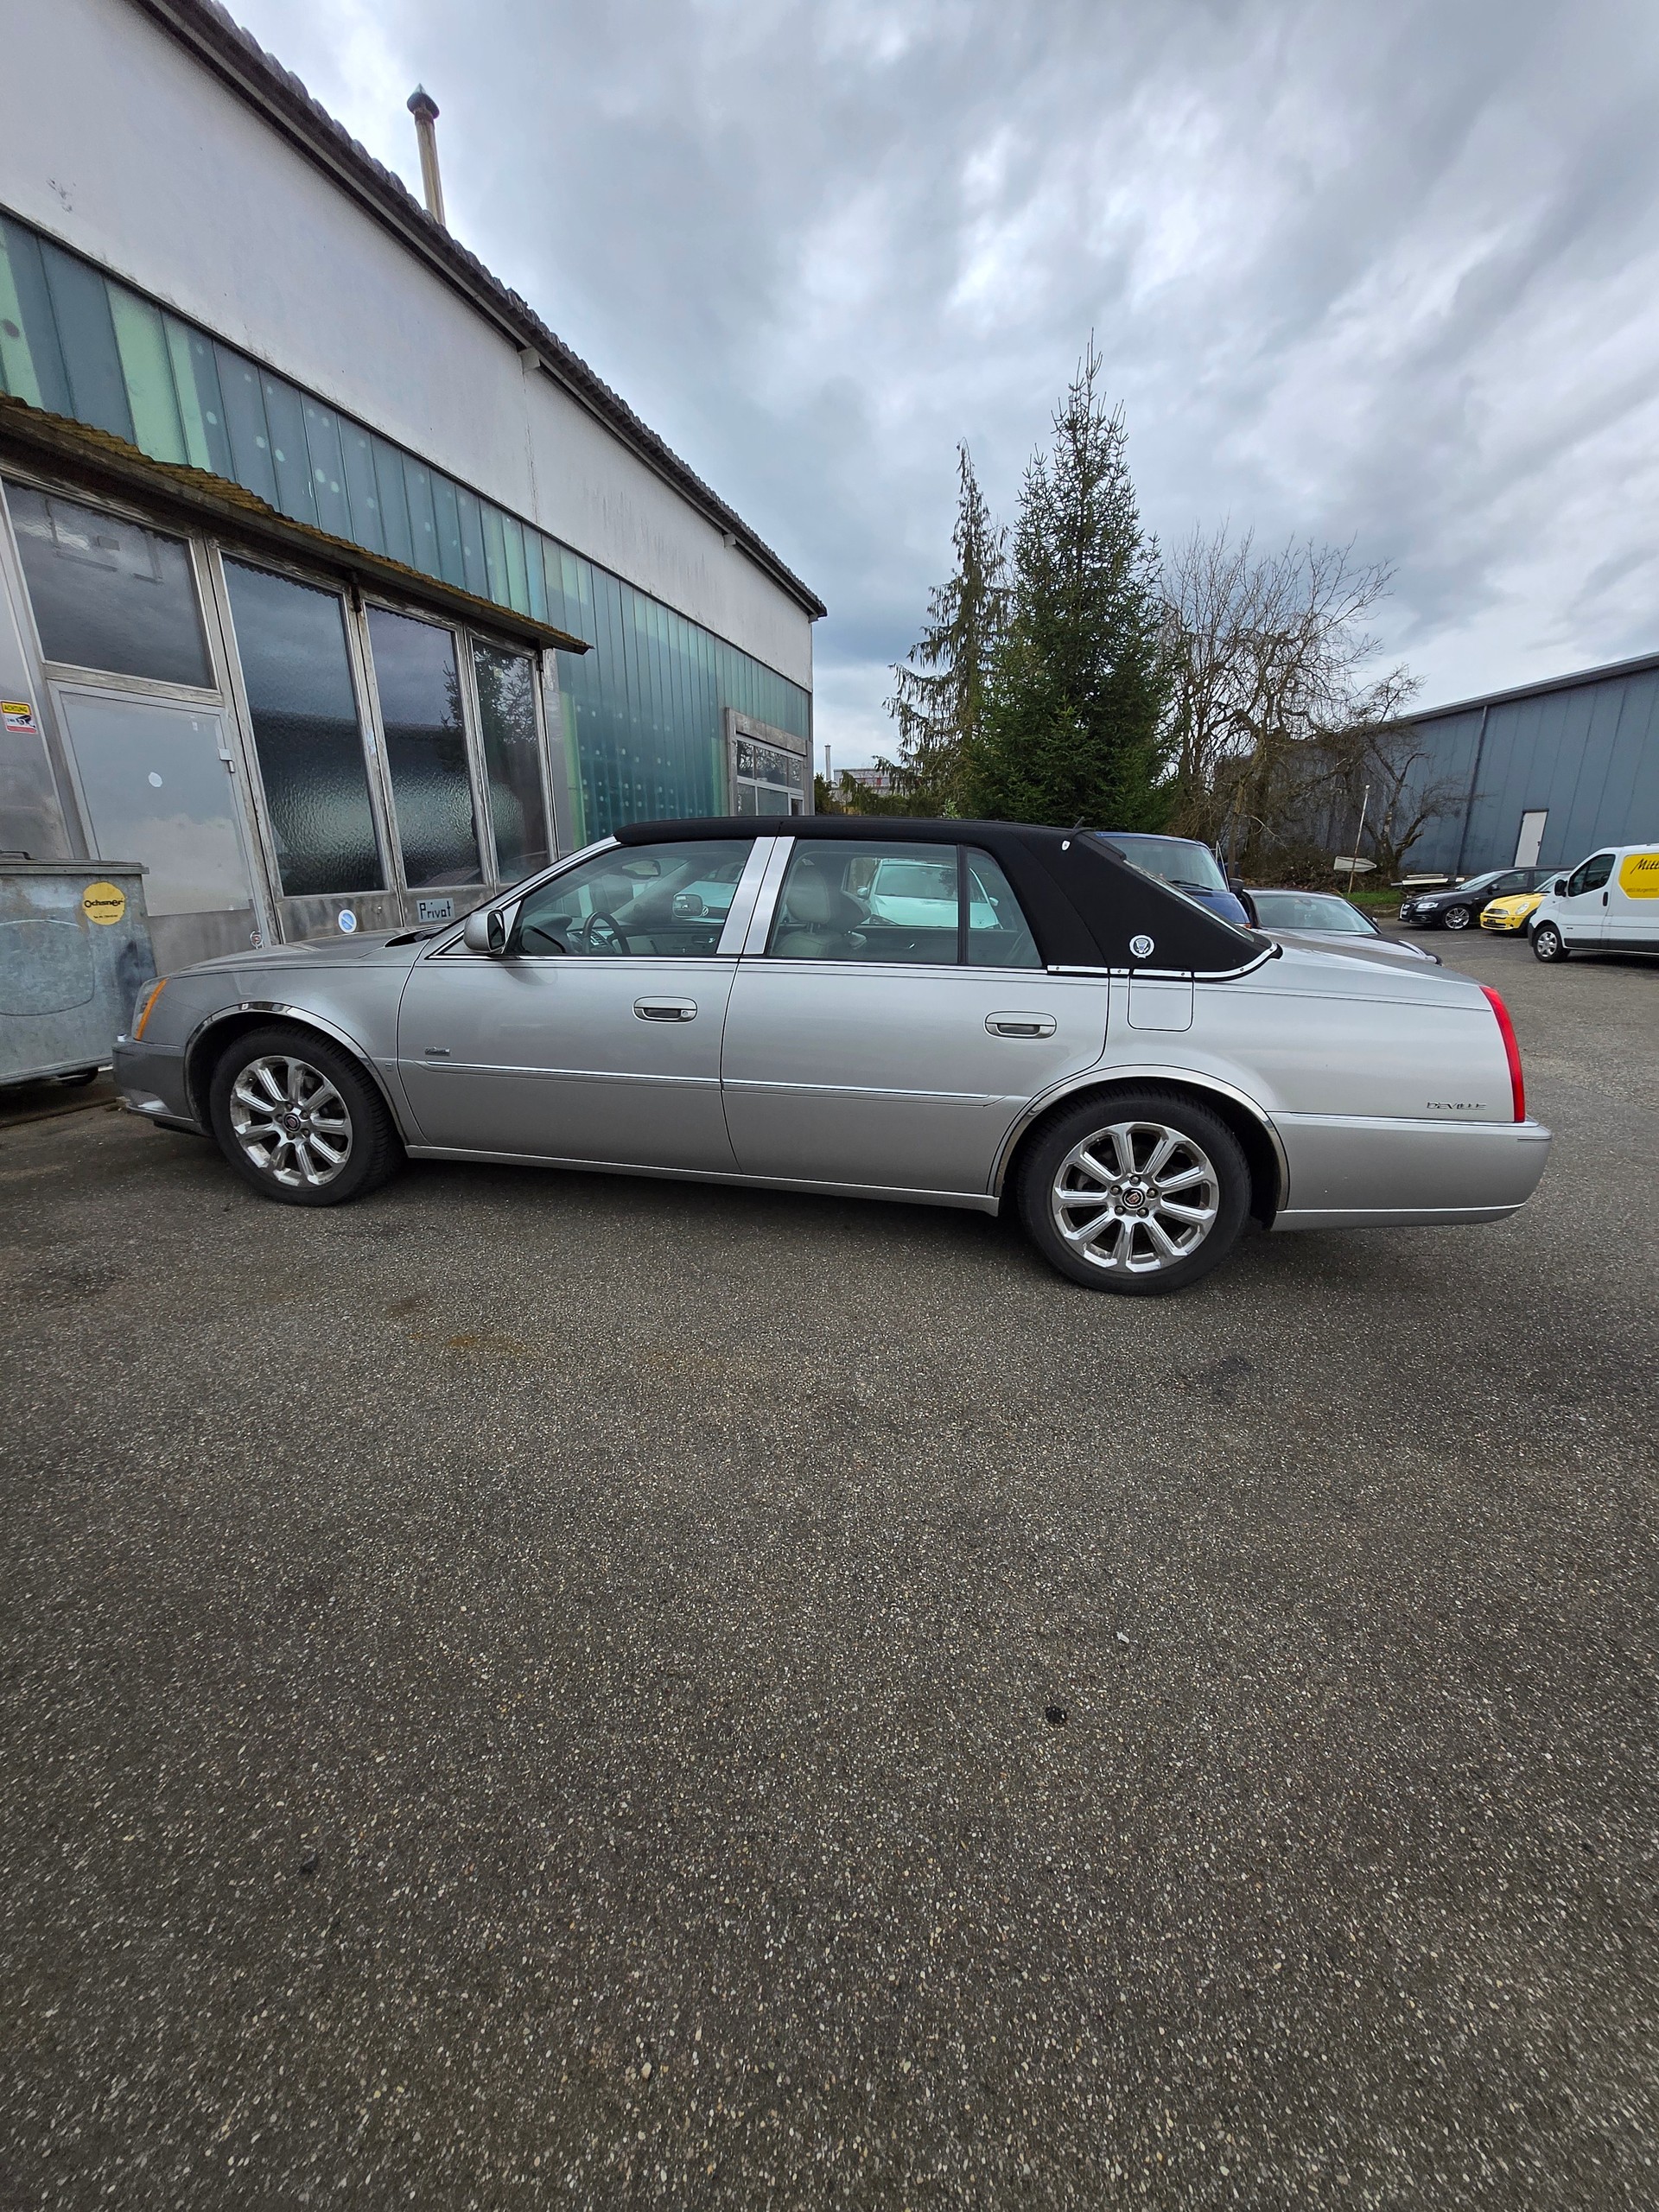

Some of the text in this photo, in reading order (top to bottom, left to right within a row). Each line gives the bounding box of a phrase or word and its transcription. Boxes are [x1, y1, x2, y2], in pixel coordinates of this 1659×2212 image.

[84, 899, 124, 908] Ochsner
[419, 900, 451, 919] Privat
[1427, 1102, 1487, 1110] DEVILLE
